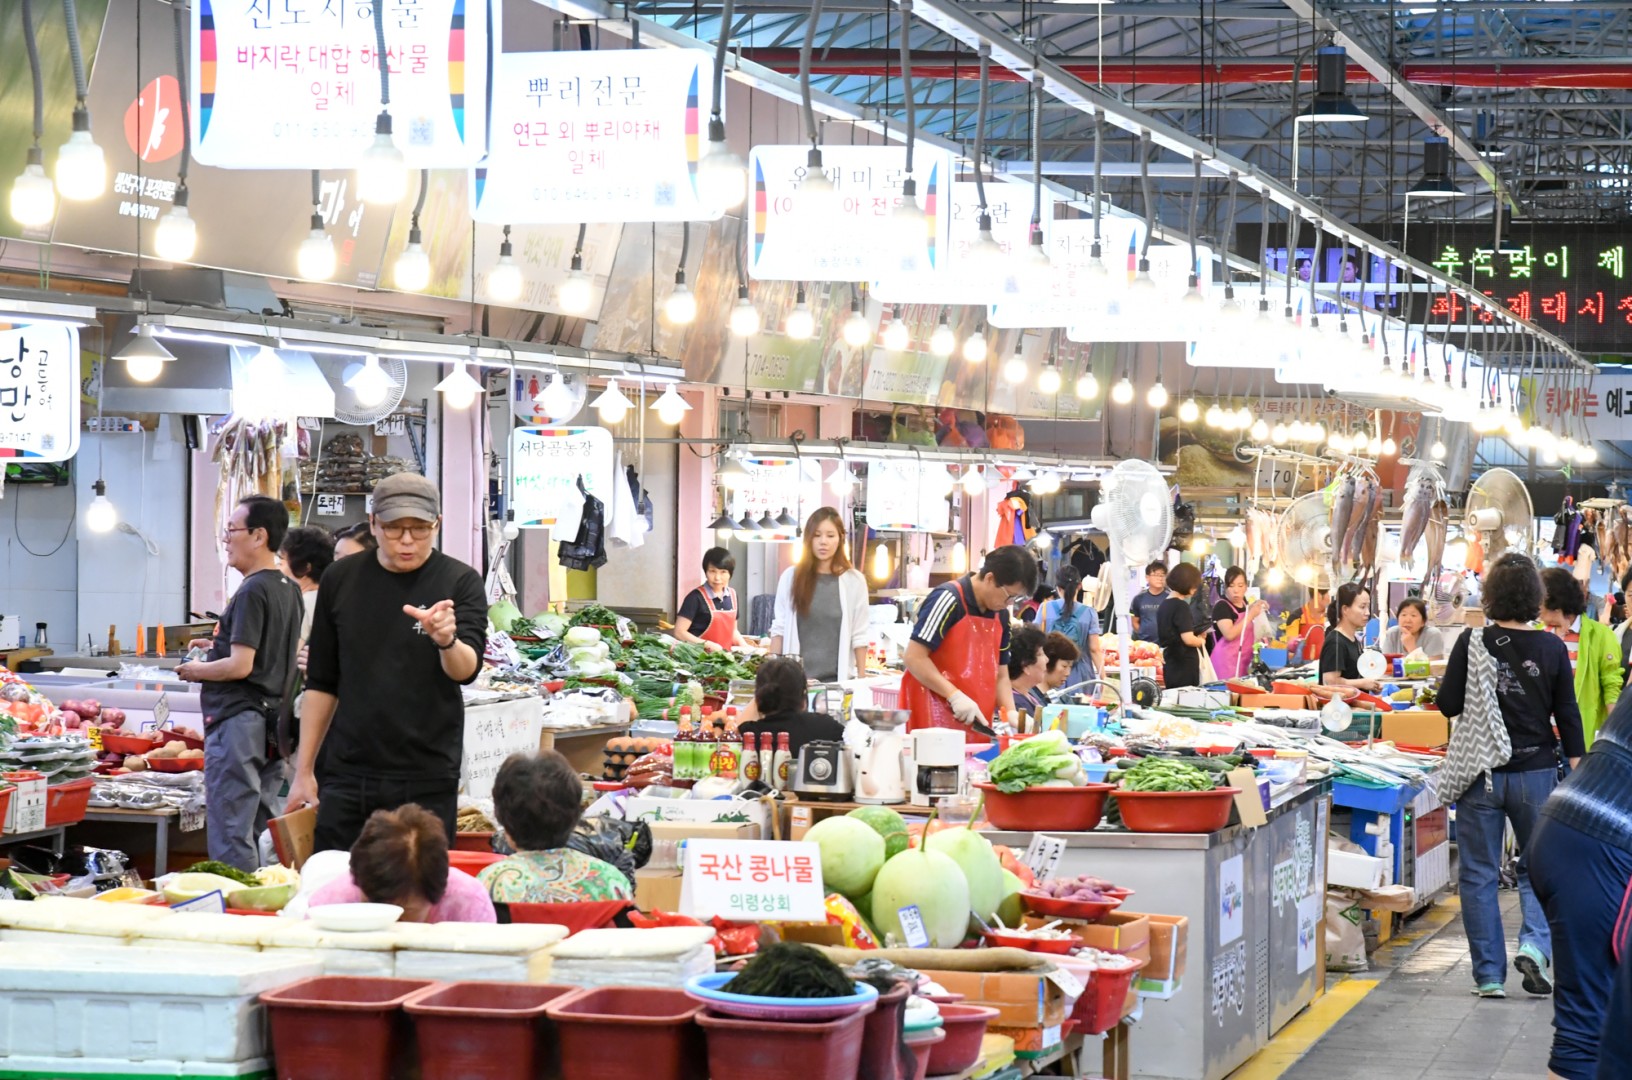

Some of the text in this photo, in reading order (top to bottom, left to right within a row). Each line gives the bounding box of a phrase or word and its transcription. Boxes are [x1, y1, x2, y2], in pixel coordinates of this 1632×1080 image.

[309, 80, 356, 111] 일체
[526, 75, 647, 109] 뿌리전문
[513, 119, 661, 147] 연근 외 뿌리야채
[568, 149, 606, 175] 일체
[1433, 245, 1569, 278] 추석맞이
[318, 496, 345, 511] 도라지
[699, 854, 814, 883] 국산 콩나물
[730, 893, 791, 912] 의령상회
